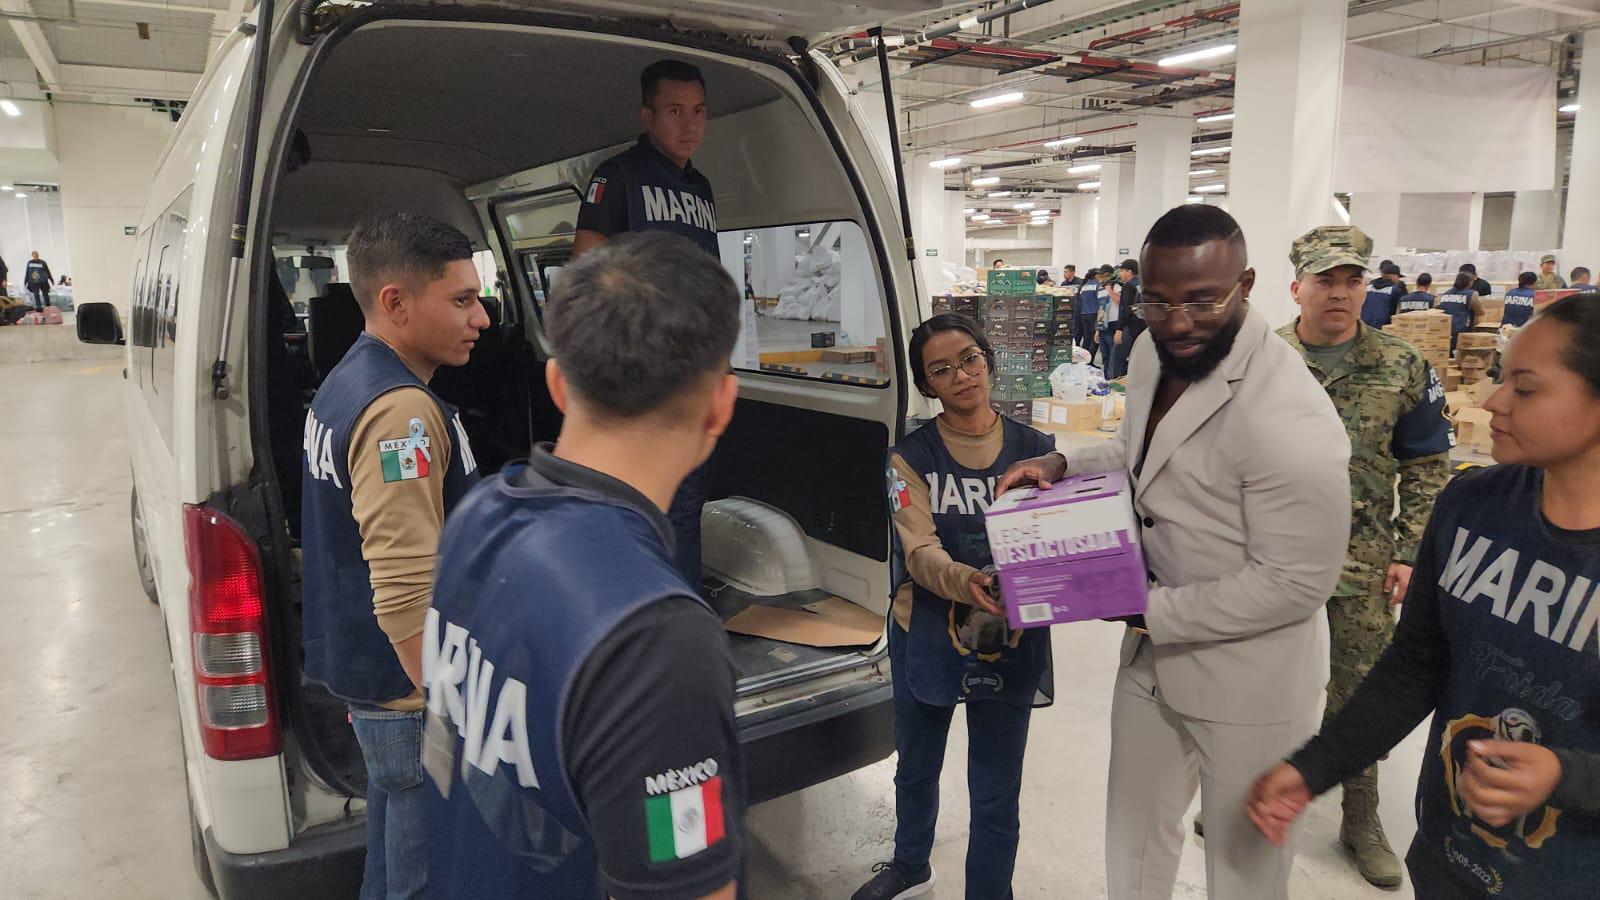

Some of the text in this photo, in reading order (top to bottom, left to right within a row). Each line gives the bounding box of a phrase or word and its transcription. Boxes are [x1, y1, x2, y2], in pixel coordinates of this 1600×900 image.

[641, 185, 717, 233] MARIN
[924, 471, 1003, 515] MARI
[1470, 640, 1584, 721] Frida
